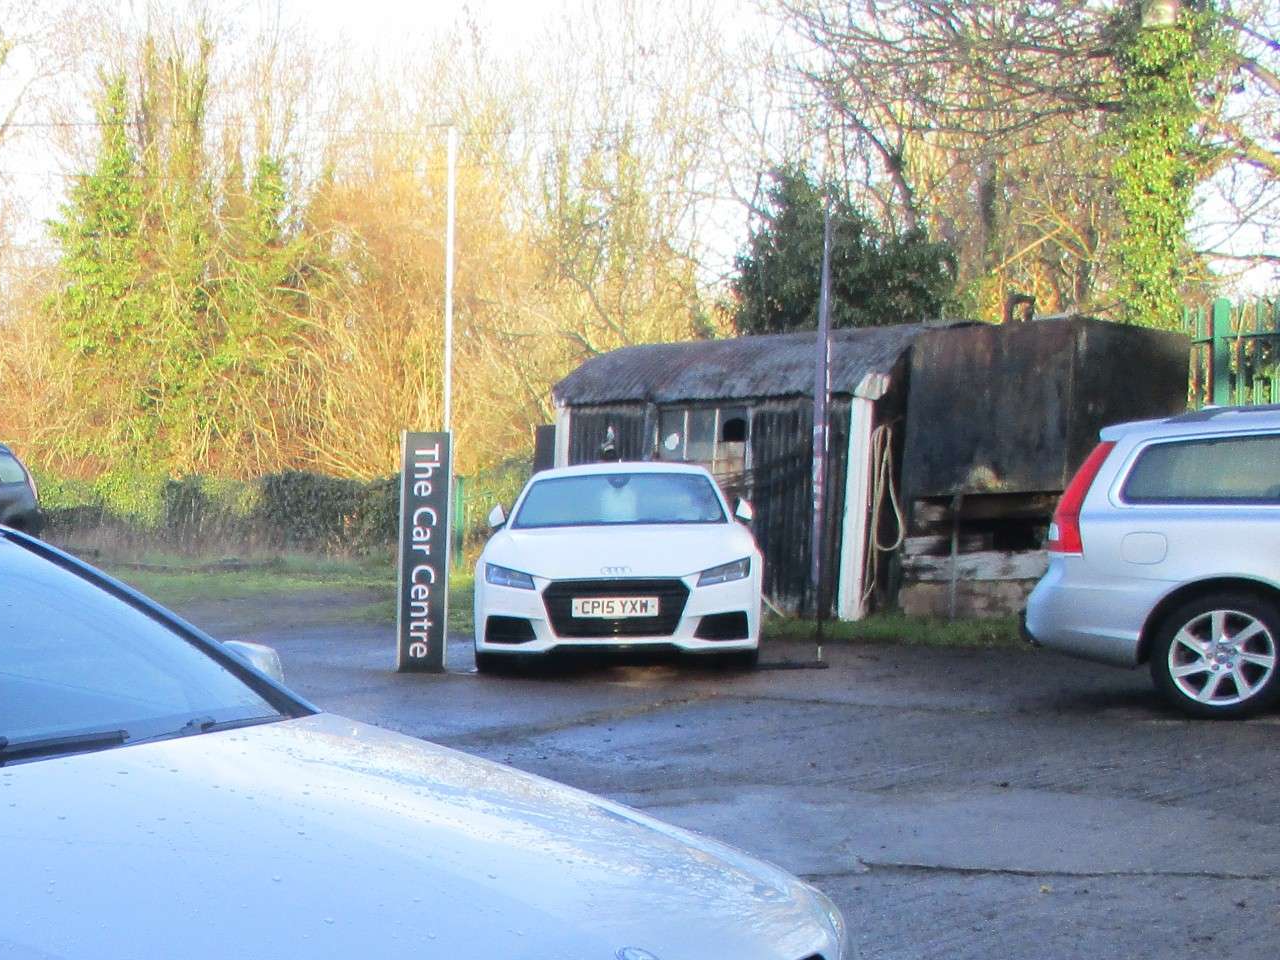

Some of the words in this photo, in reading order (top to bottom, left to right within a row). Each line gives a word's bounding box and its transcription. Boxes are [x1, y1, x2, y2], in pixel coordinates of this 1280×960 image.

[412, 443, 441, 498] The
[411, 506, 437, 556] Car
[408, 564, 436, 660] Centre
[581, 600, 615, 614] CP15
